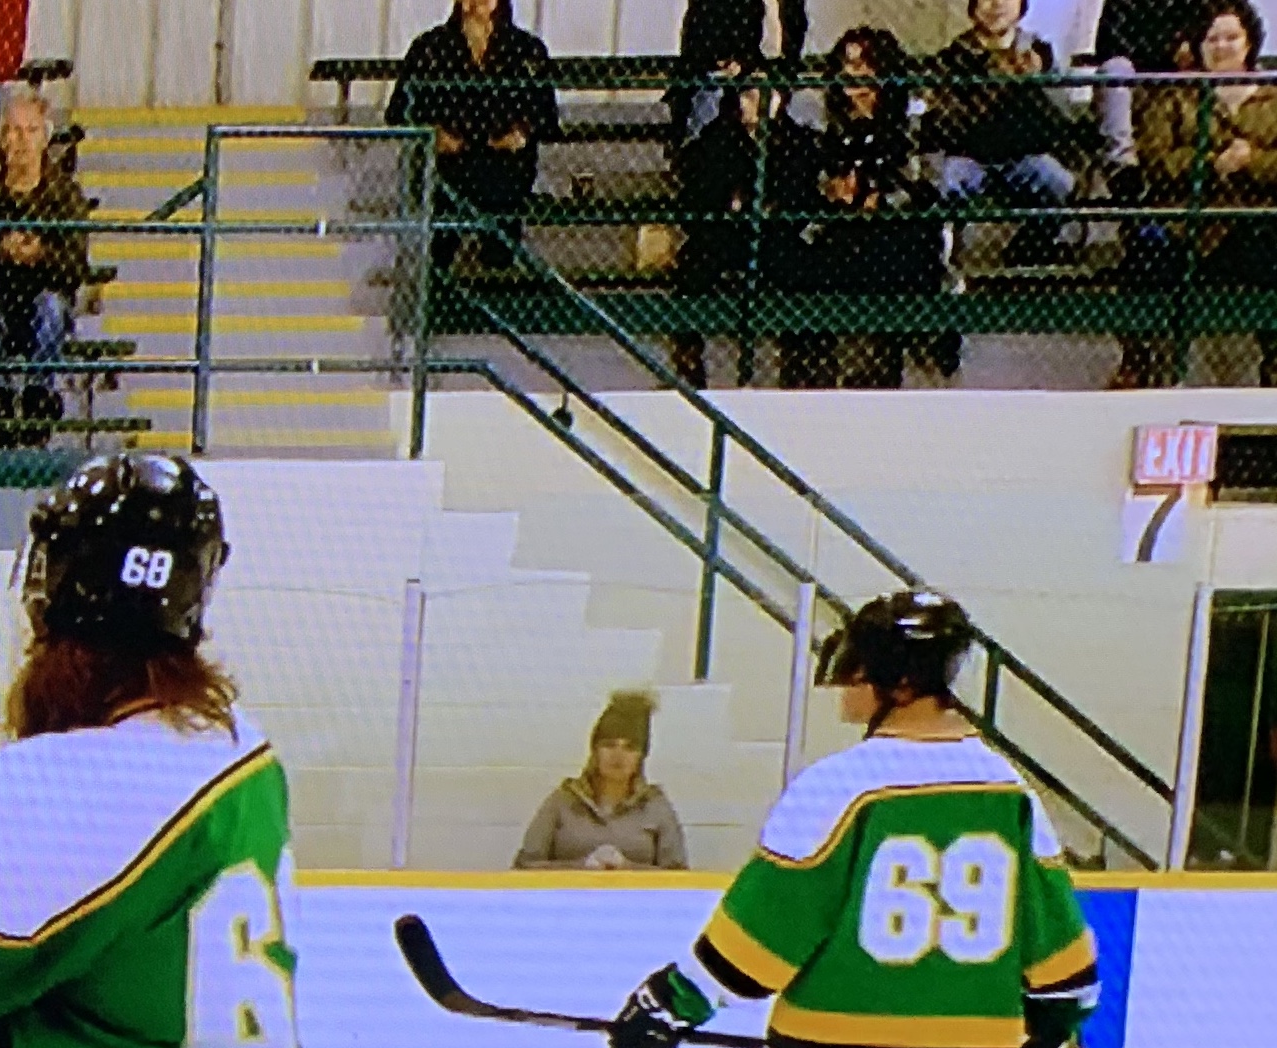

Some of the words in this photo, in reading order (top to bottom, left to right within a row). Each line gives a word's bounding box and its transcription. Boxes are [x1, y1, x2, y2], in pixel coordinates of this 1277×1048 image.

[1142, 426, 1211, 481] EXIT
[1133, 483, 1183, 562] 7
[119, 545, 174, 590] 68
[858, 832, 1020, 966] 69
